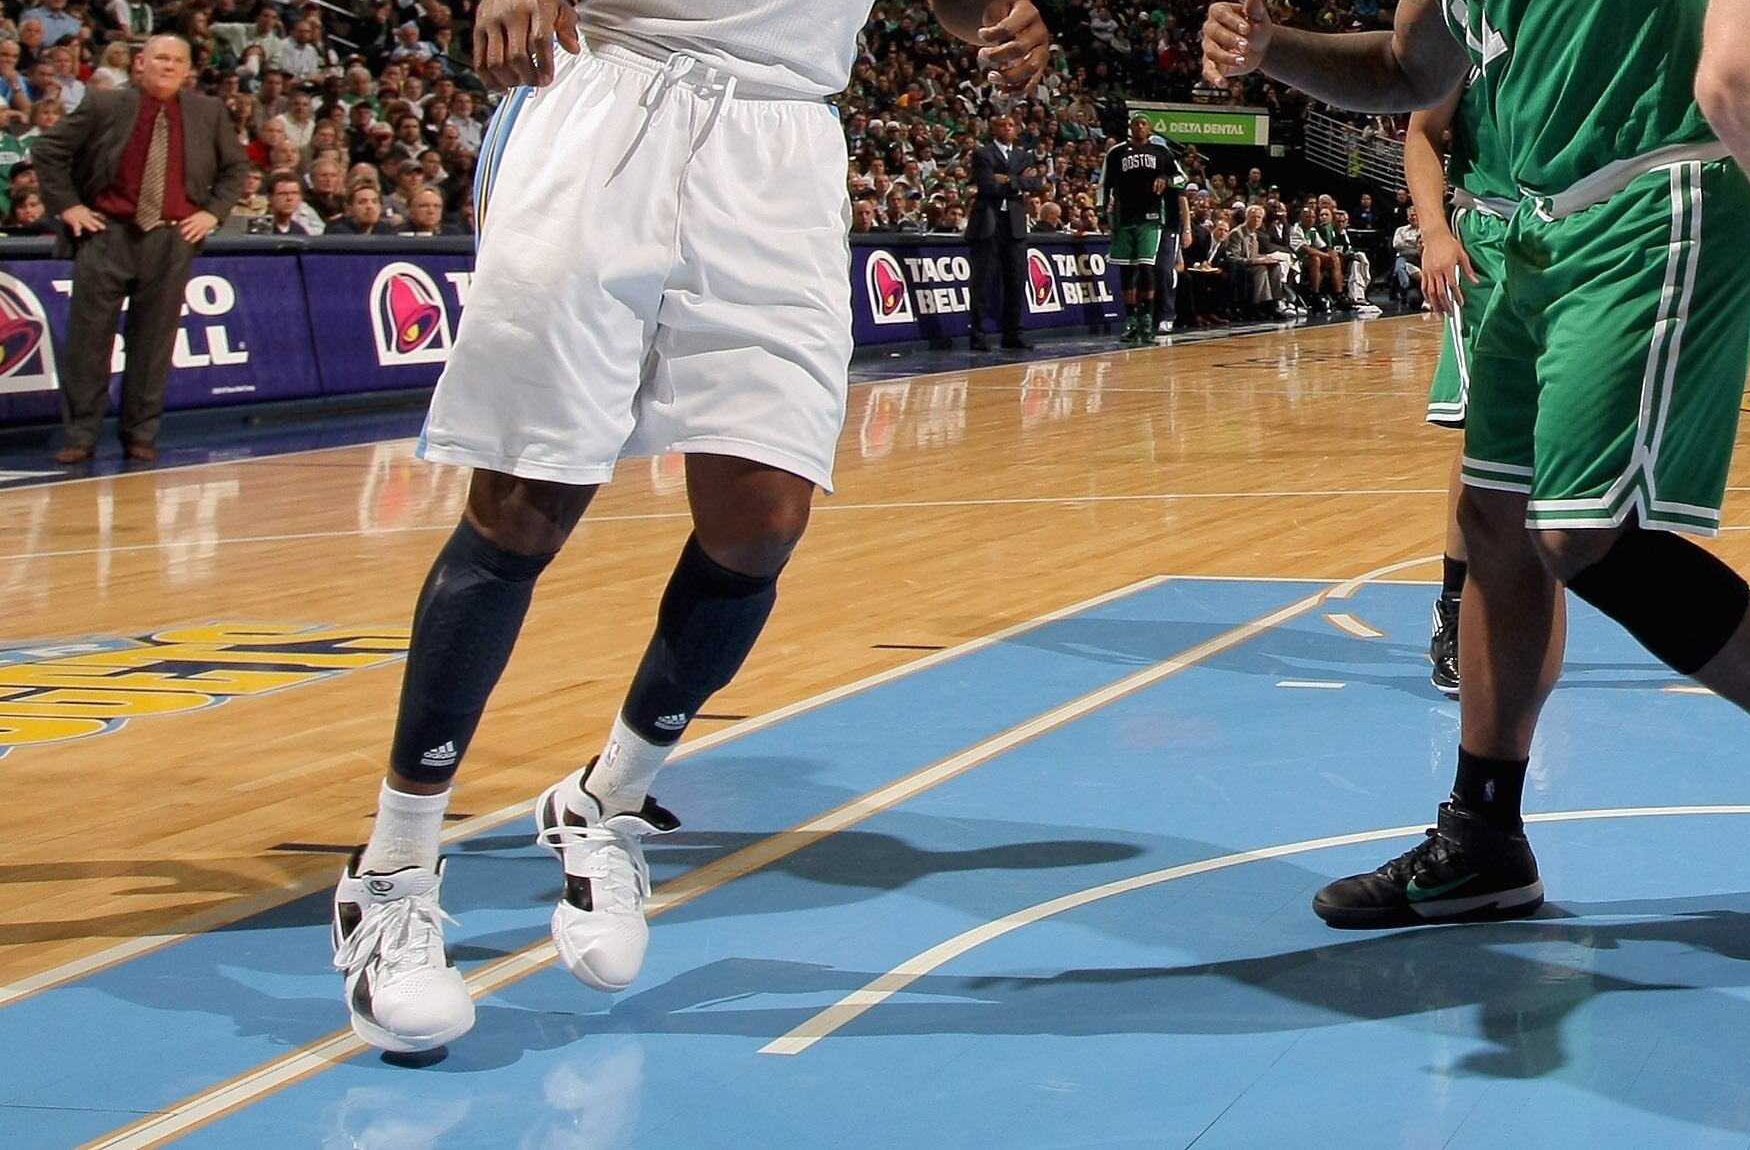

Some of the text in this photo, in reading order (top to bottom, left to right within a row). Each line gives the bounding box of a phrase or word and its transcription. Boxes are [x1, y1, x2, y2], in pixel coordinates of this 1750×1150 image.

[1169, 121, 1245, 136] DELTA DENTAL
[1121, 152, 1157, 173] BOSTON
[903, 256, 972, 283] TACO
[1050, 252, 1107, 278] TACO
[1060, 280, 1115, 306] BELL
